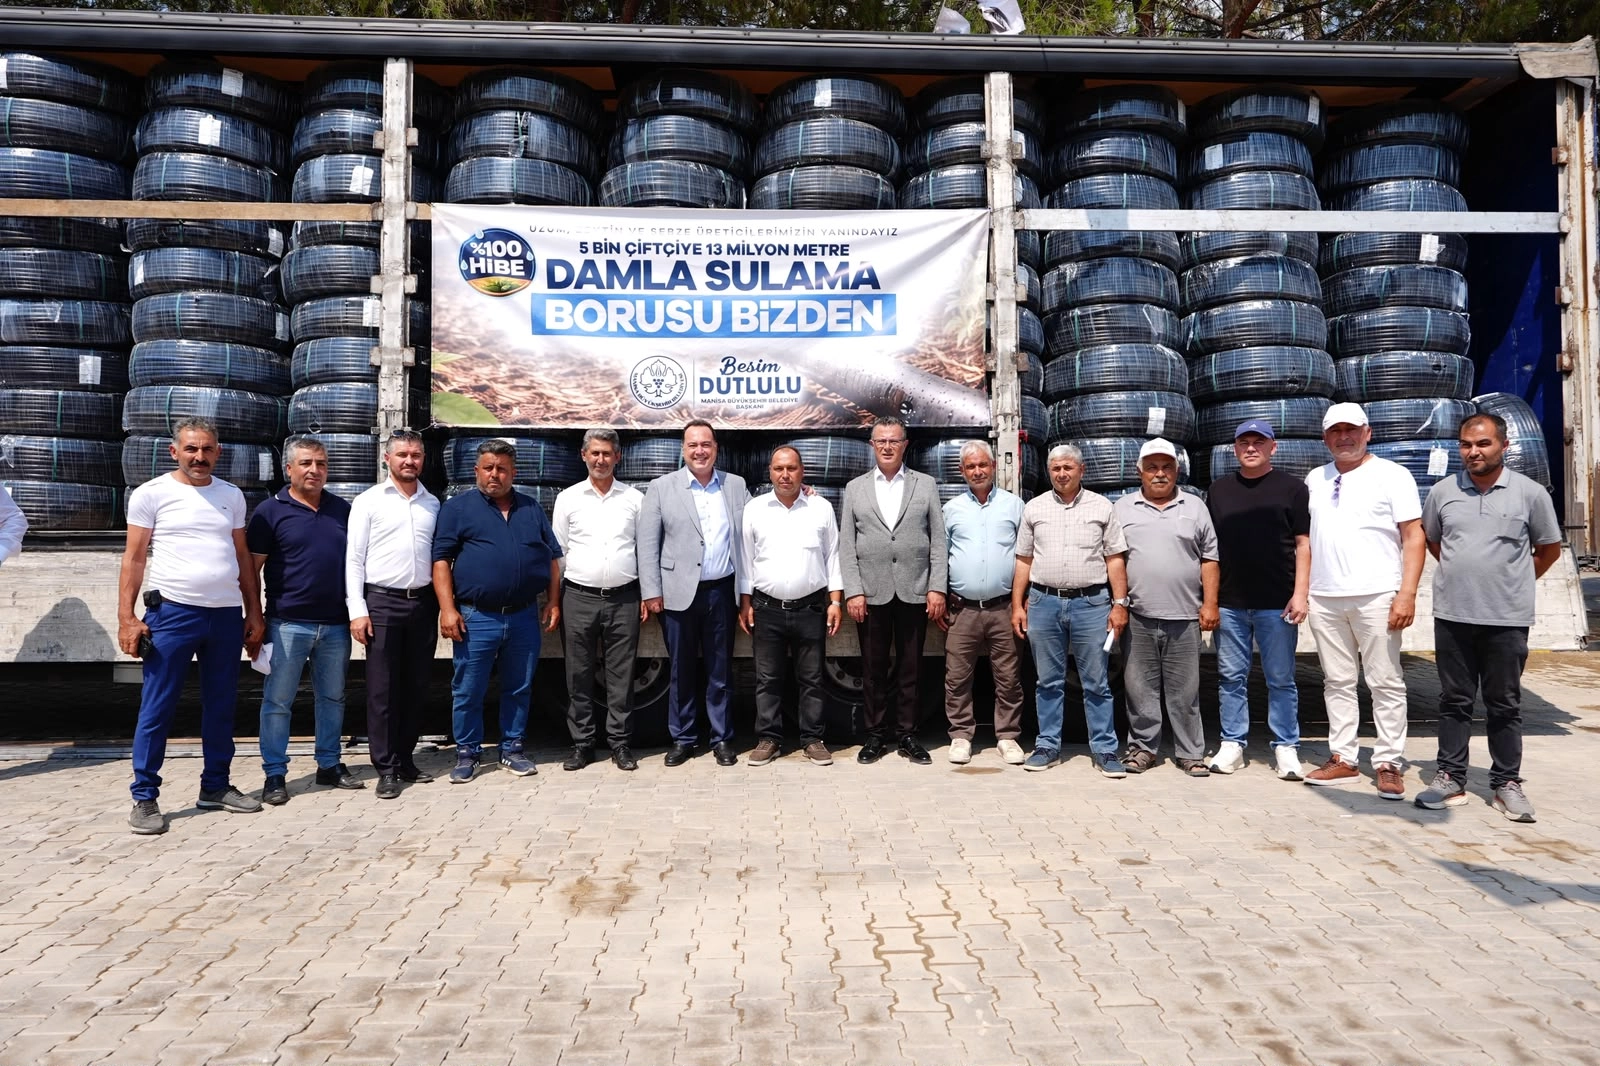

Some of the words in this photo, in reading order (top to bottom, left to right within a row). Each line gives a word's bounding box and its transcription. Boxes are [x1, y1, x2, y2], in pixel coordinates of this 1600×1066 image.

[696, 226, 815, 236] ÜRETİCİLERİMİZİN
[821, 228, 898, 236] YANINDAYIZ
[469, 240, 522, 258] %100
[579, 241, 589, 254] 5
[593, 238, 621, 255] BİN
[625, 238, 703, 257] ÇİFTÇİYE
[706, 243, 722, 255] 13
[726, 240, 789, 256] MİLYON
[793, 243, 850, 257] METRE
[546, 258, 697, 291] DAMLA
[705, 260, 881, 291] SULAMA
[545, 299, 723, 333] BORUSU
[719, 355, 781, 375] Besim
[699, 376, 801, 395] DUTLULU
